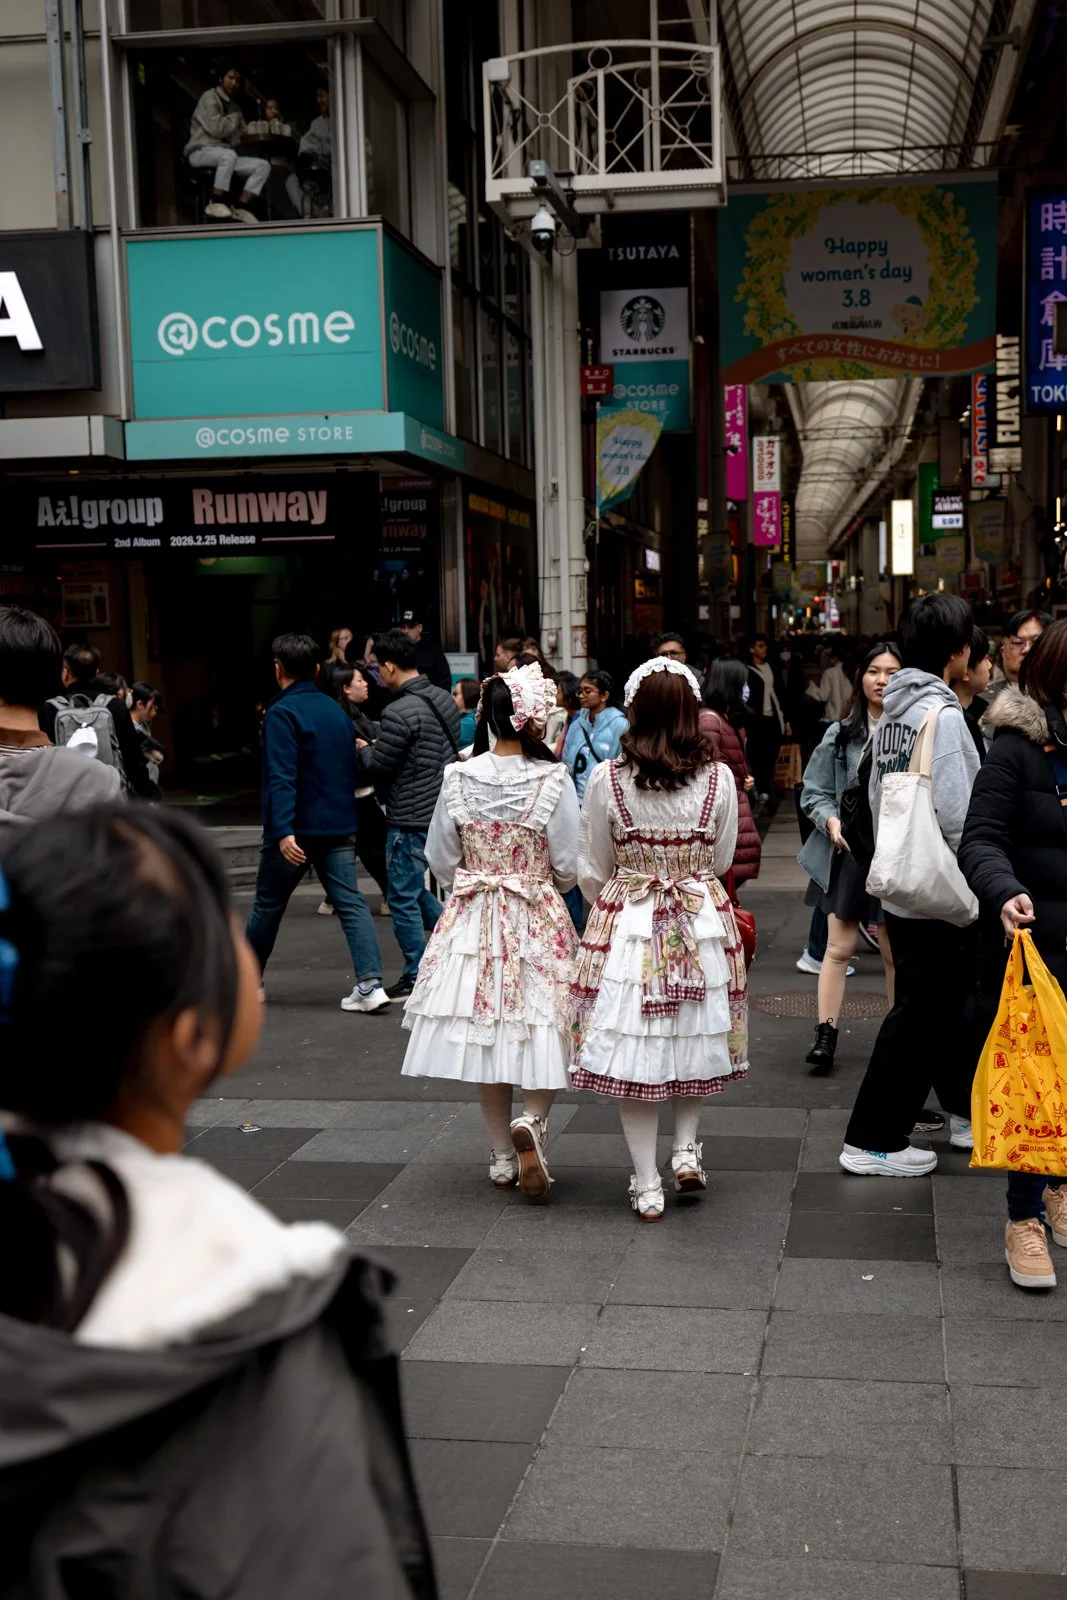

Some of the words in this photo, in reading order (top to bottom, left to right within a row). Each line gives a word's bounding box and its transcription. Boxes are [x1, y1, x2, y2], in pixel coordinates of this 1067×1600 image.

[608, 245, 680, 261] TSUTAYA
[824, 237, 888, 258] Happy
[800, 264, 876, 282] women's
[881, 263, 913, 283] day
[842, 288, 872, 308] 3.8
[157, 310, 355, 355] @cosme
[390, 311, 437, 371] @cosme
[612, 347, 676, 357] STARBUCKS
[995, 333, 1021, 377] HAT
[613, 383, 680, 398] @cosme
[626, 399, 667, 410] STORE
[195, 426, 291, 448] @cosme
[297, 425, 354, 442] STORE
[766, 440, 775, 480] カラオケ
[193, 488, 328, 526] Runway
[114, 538, 131, 548] 2nd
[133, 537, 161, 548] Album
[170, 535, 217, 547] 2026.2.25
[219, 534, 256, 546] Release
